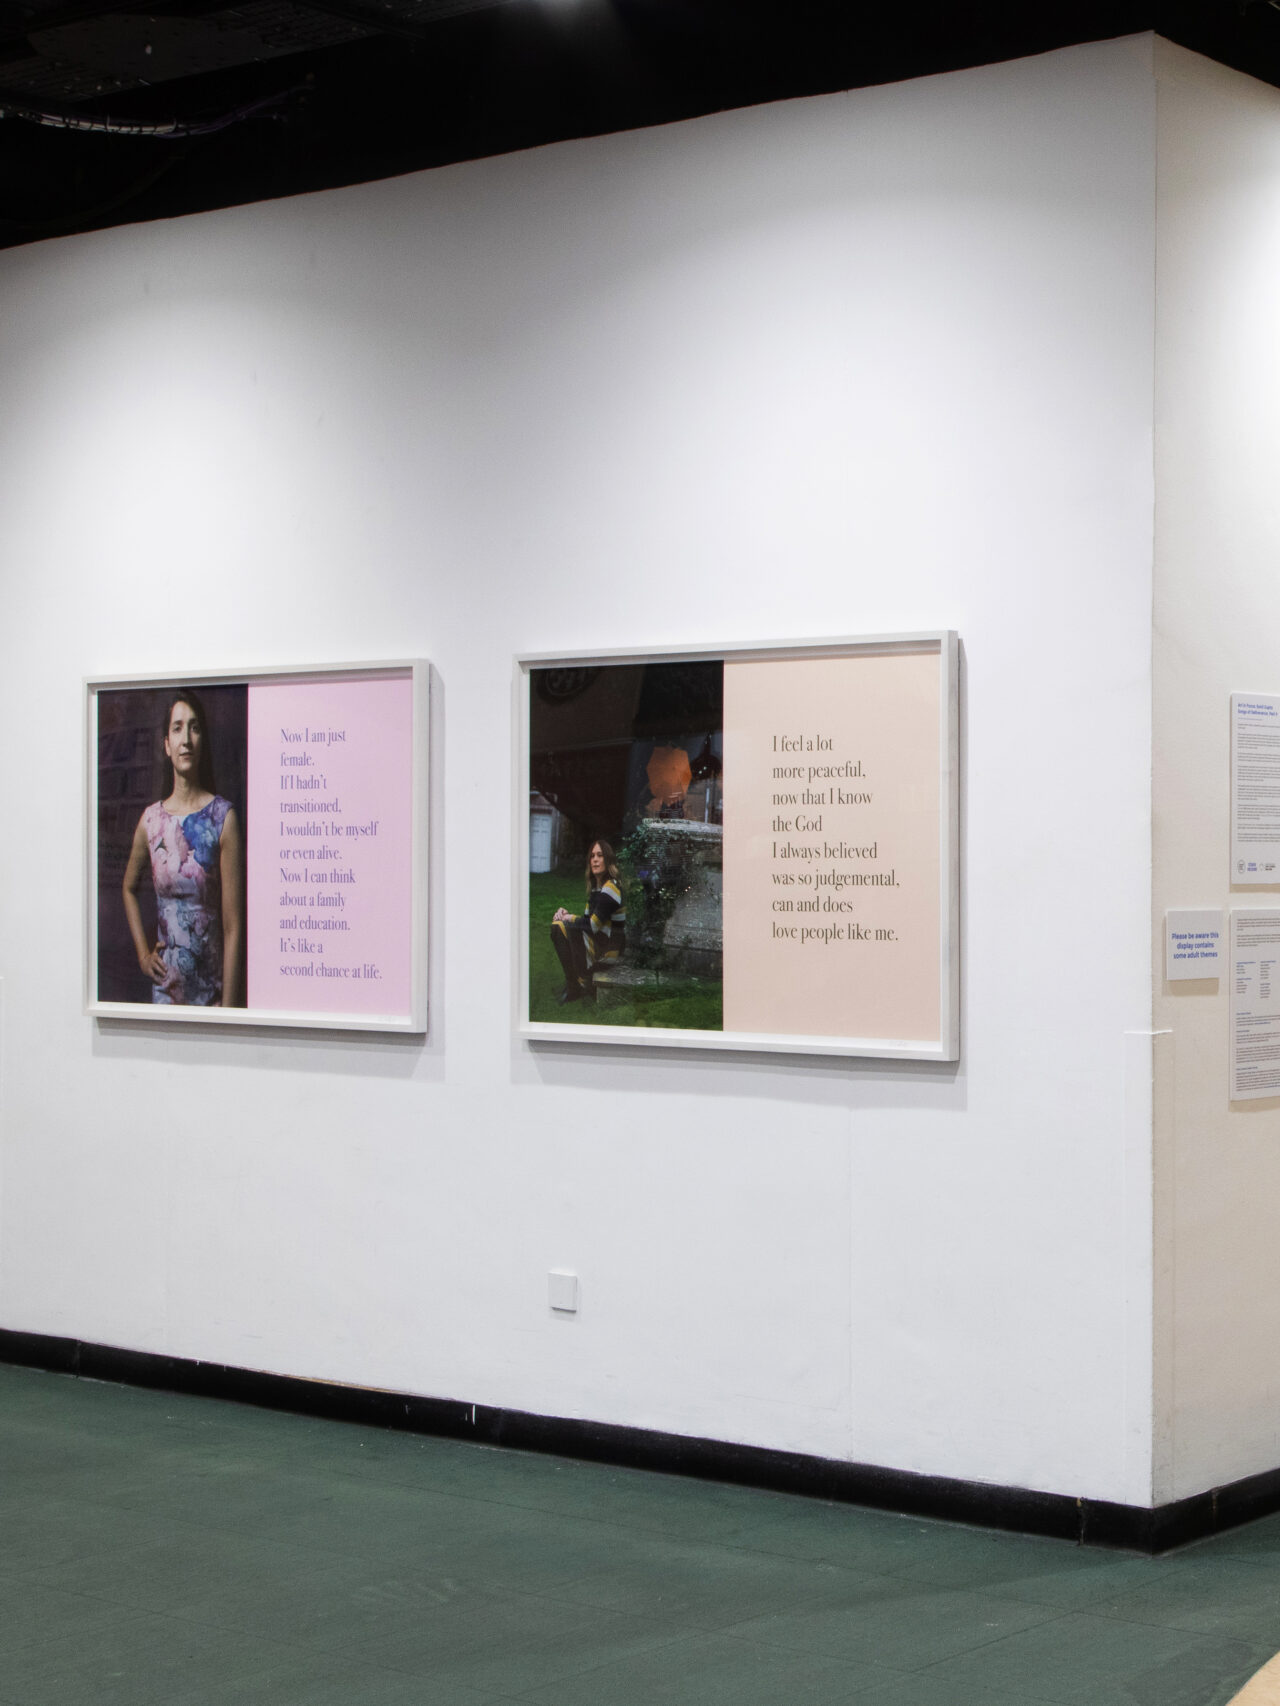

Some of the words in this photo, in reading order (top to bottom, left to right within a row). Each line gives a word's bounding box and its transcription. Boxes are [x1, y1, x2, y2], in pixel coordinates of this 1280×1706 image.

[280, 728, 302, 743] Now
[305, 727, 309, 743] I
[311, 732, 326, 742] am
[327, 727, 346, 747] just
[773, 735, 777, 752] I
[781, 735, 803, 752] feel
[806, 739, 813, 752] a
[816, 734, 833, 751] lot
[280, 751, 315, 767] female.
[772, 766, 805, 779] more
[808, 761, 866, 783] peaceful,
[280, 775, 290, 790] If
[290, 775, 294, 790] I
[772, 793, 799, 805] now
[802, 788, 825, 805] that
[830, 787, 834, 805] I
[838, 787, 873, 805] know
[280, 821, 284, 836] I
[331, 821, 343, 836] be
[346, 820, 379, 841] myself
[772, 815, 792, 832] the
[795, 815, 822, 832] God
[280, 849, 291, 860] or
[292, 849, 315, 860] even
[317, 845, 342, 860] alive.
[773, 842, 777, 858] I
[780, 842, 821, 864] always
[824, 842, 877, 858] believed
[280, 867, 302, 883] Now
[304, 867, 308, 883] I
[310, 872, 328, 883] can
[330, 868, 356, 883] think
[772, 873, 795, 885] was
[798, 873, 812, 885] so
[814, 868, 900, 891] judgemental,
[280, 891, 307, 907] about
[309, 896, 315, 907] a
[317, 892, 346, 912] family
[772, 900, 793, 912] can
[797, 895, 820, 912] and
[823, 895, 853, 913] does
[280, 914, 297, 930] and
[299, 915, 351, 931] education.
[772, 921, 798, 939] love
[801, 922, 844, 944] people
[848, 923, 871, 940] like
[875, 928, 899, 941] me.
[1171, 932, 1187, 940] Please
[1210, 931, 1219, 939] this
[297, 937, 315, 953] like
[317, 942, 324, 953] a
[1177, 942, 1193, 950] display
[1195, 941, 1215, 949] contains
[280, 961, 314, 977] second
[315, 962, 349, 978] chance
[352, 967, 361, 978] at
[363, 963, 382, 979] life.
